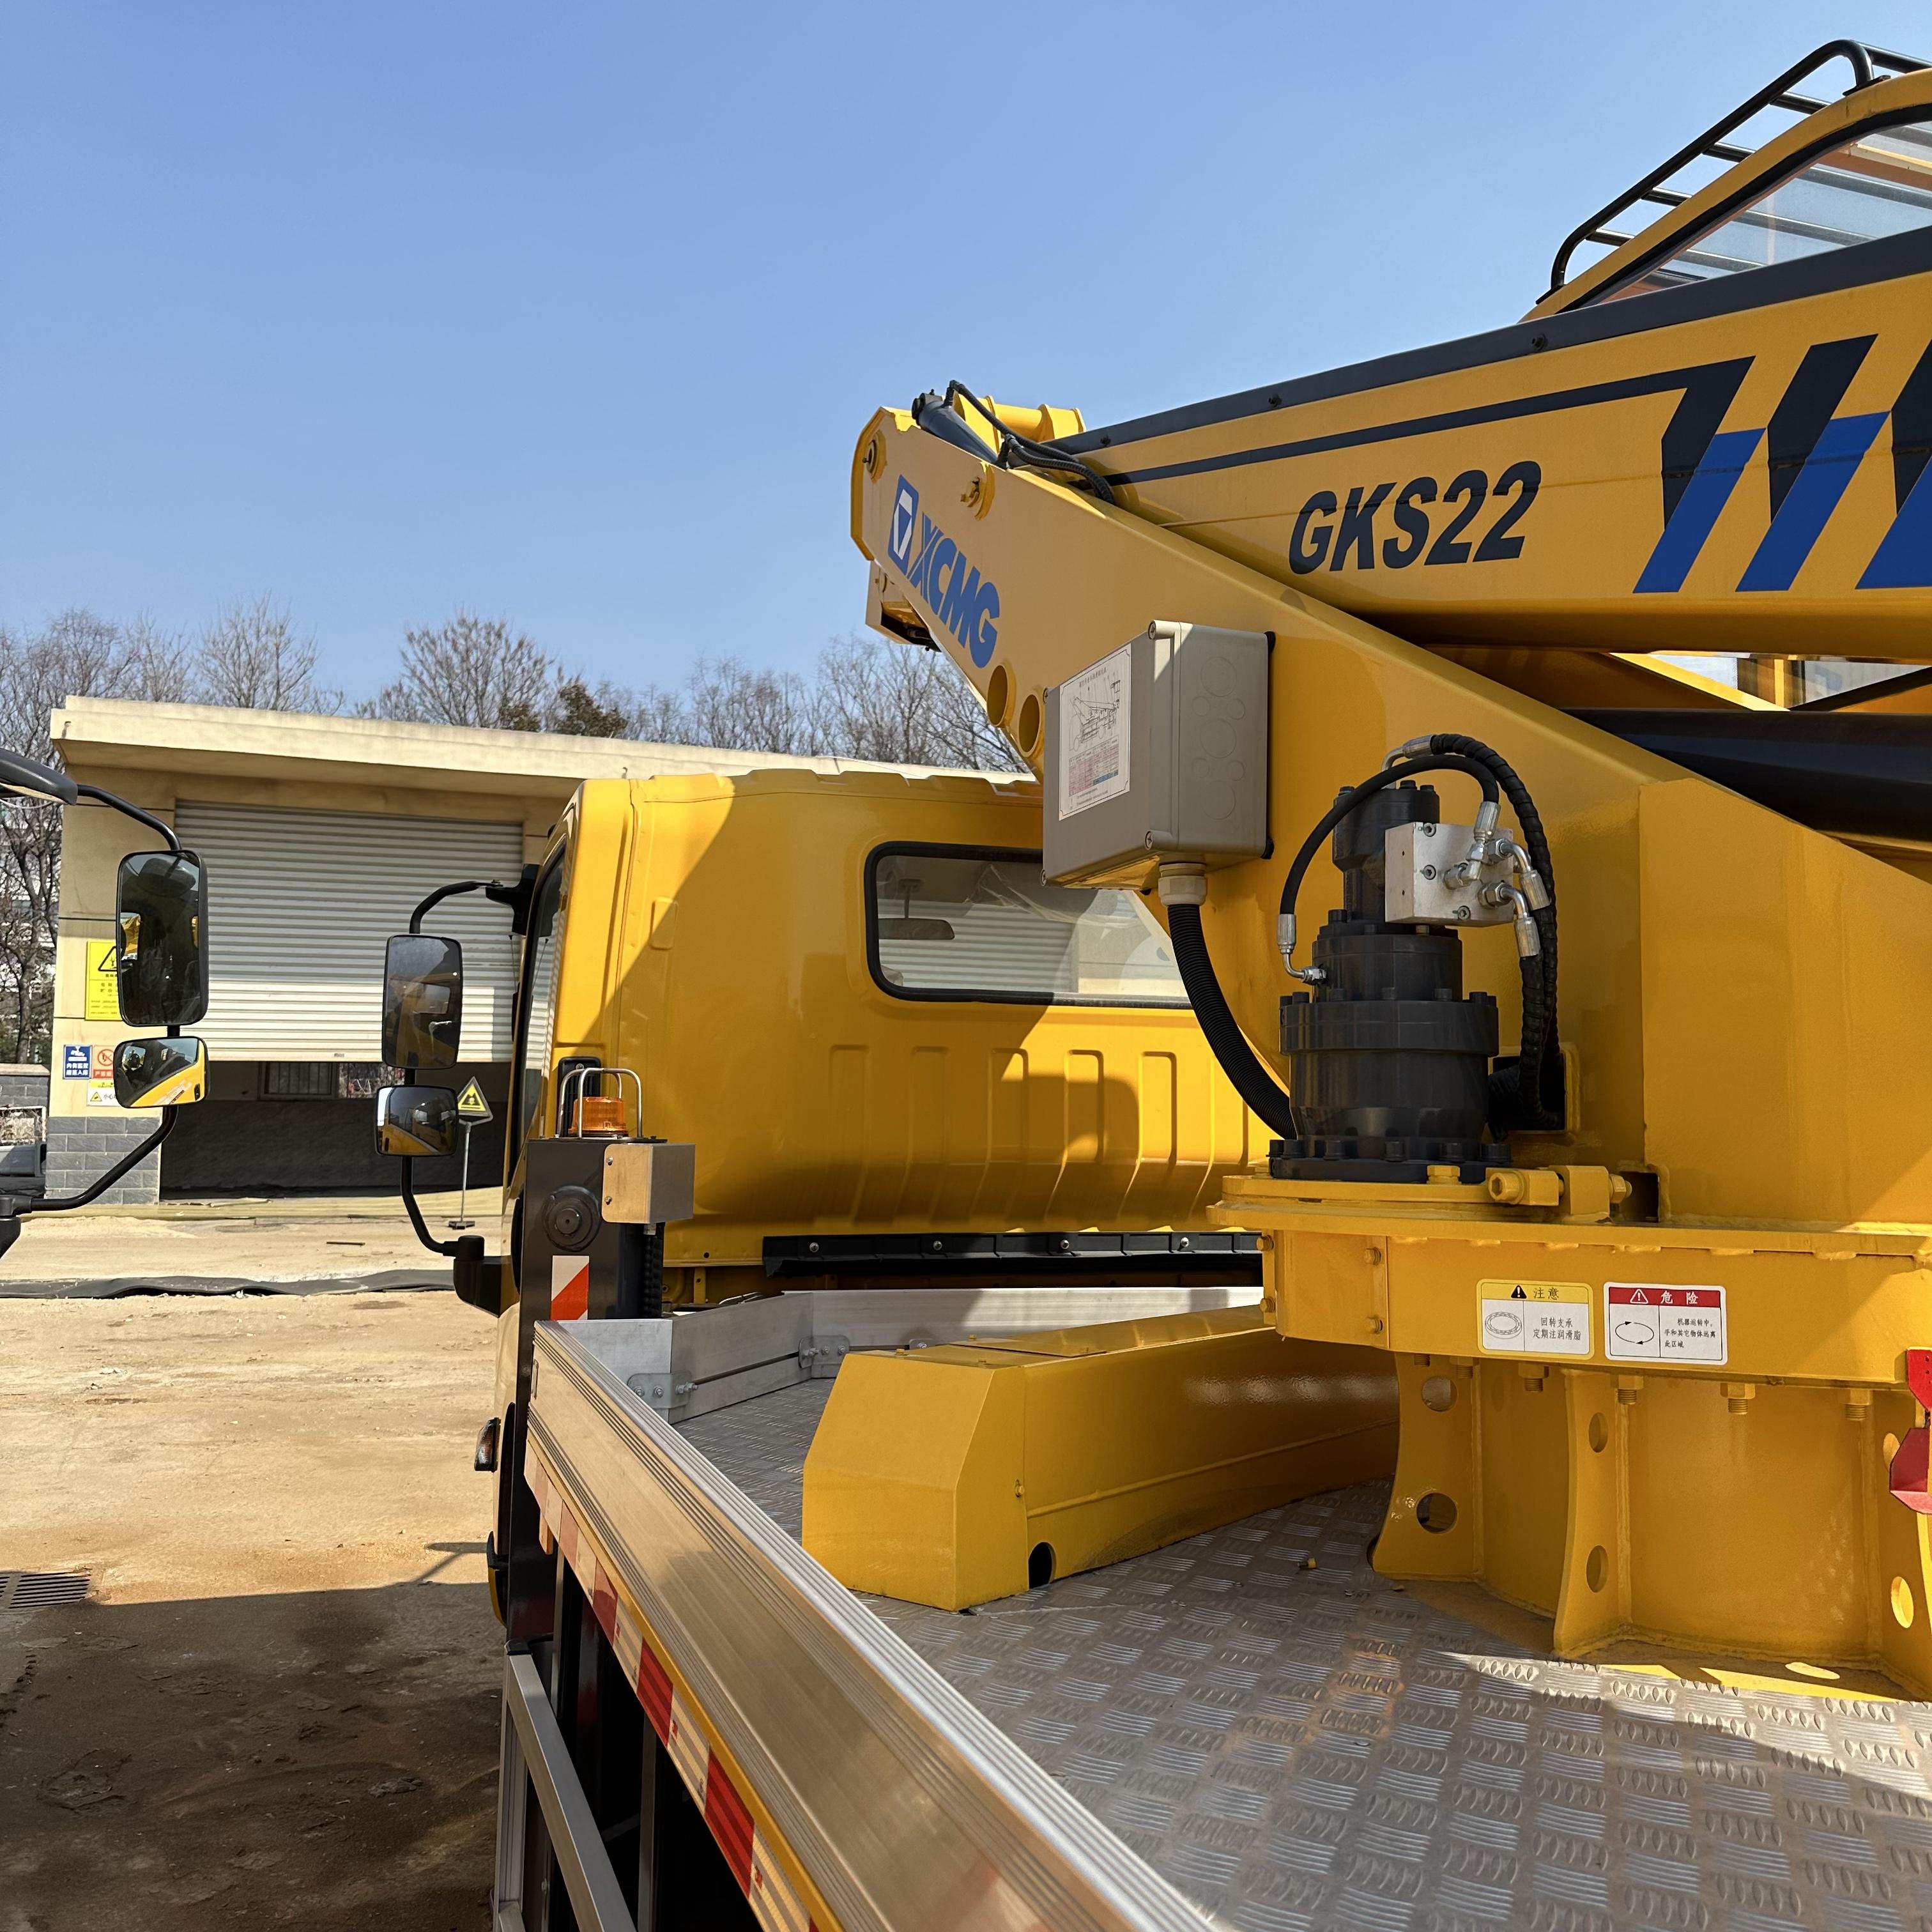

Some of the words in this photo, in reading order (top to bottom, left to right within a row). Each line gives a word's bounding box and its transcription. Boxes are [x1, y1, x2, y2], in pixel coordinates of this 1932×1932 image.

[1289, 461, 1541, 574] GKS22
[906, 511, 1000, 668] XCMG
[1533, 1287, 1559, 1300] 注意
[1660, 1290, 1698, 1305] 危险
[1540, 1317, 1573, 1328] 回转支承
[1533, 1329, 1581, 1340] 定期注润滑脂
